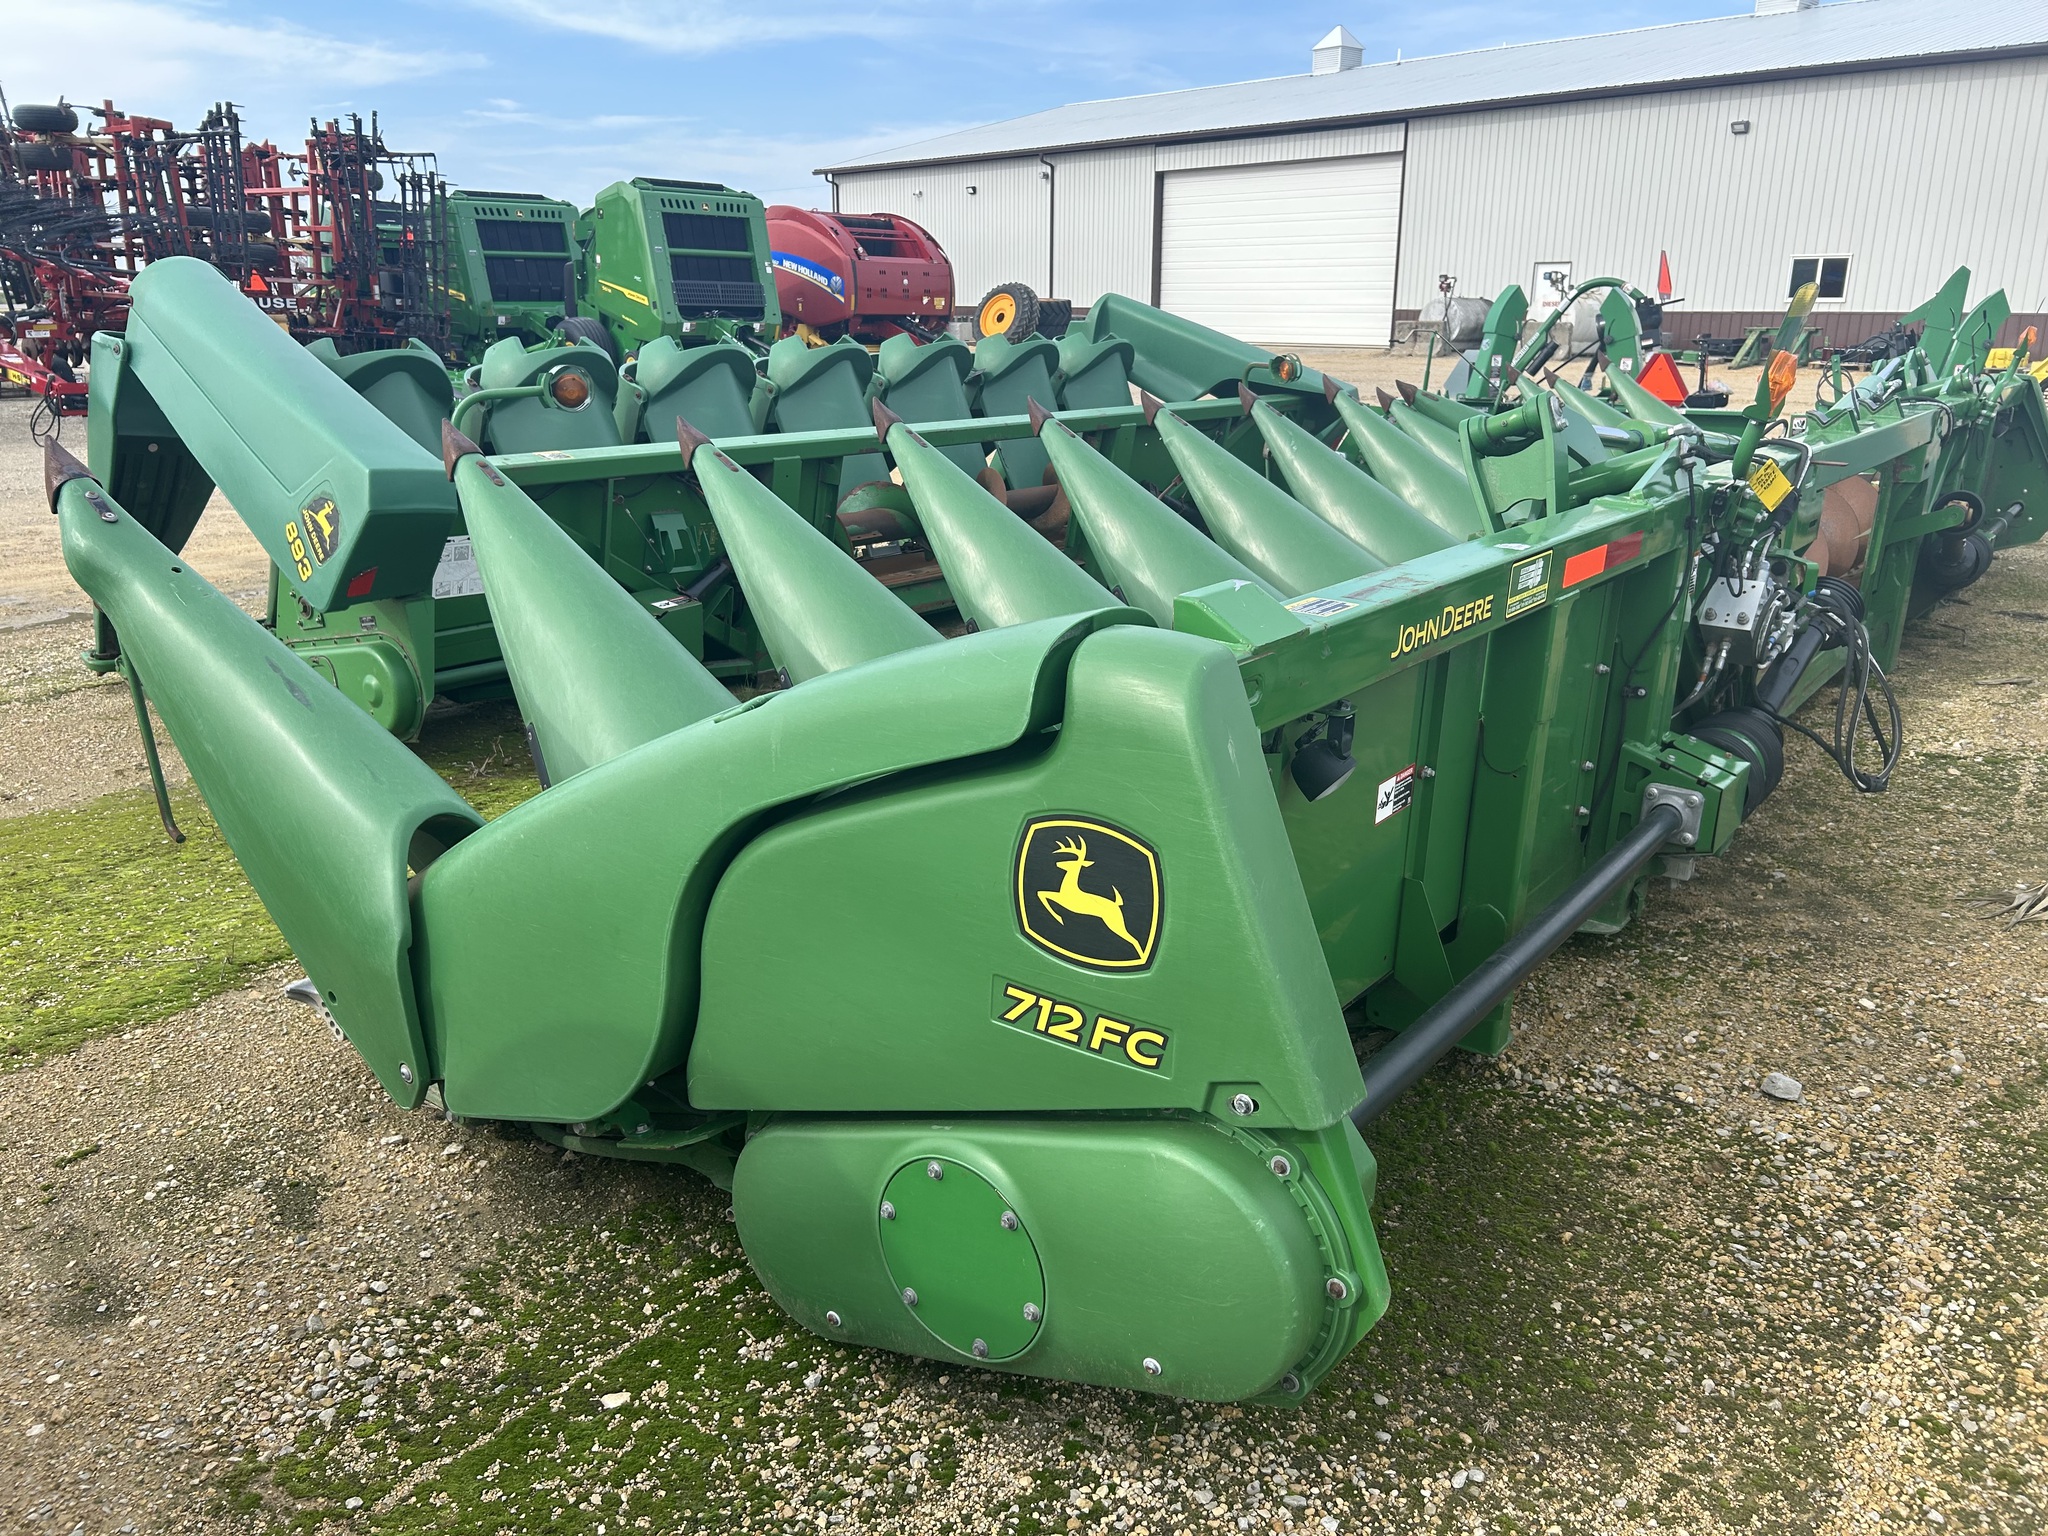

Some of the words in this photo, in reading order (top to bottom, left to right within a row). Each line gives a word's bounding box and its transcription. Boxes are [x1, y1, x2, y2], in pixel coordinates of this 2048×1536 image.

[782, 259, 798, 272] NEW
[797, 265, 829, 286] HOLLAND
[285, 521, 313, 582] 893
[302, 508, 315, 533] JOHN
[310, 531, 325, 561] DEERE
[1390, 615, 1440, 659] JOHN
[1441, 594, 1494, 637] DEERE
[1000, 984, 1086, 1045] 712
[1088, 1015, 1168, 1068] FC
